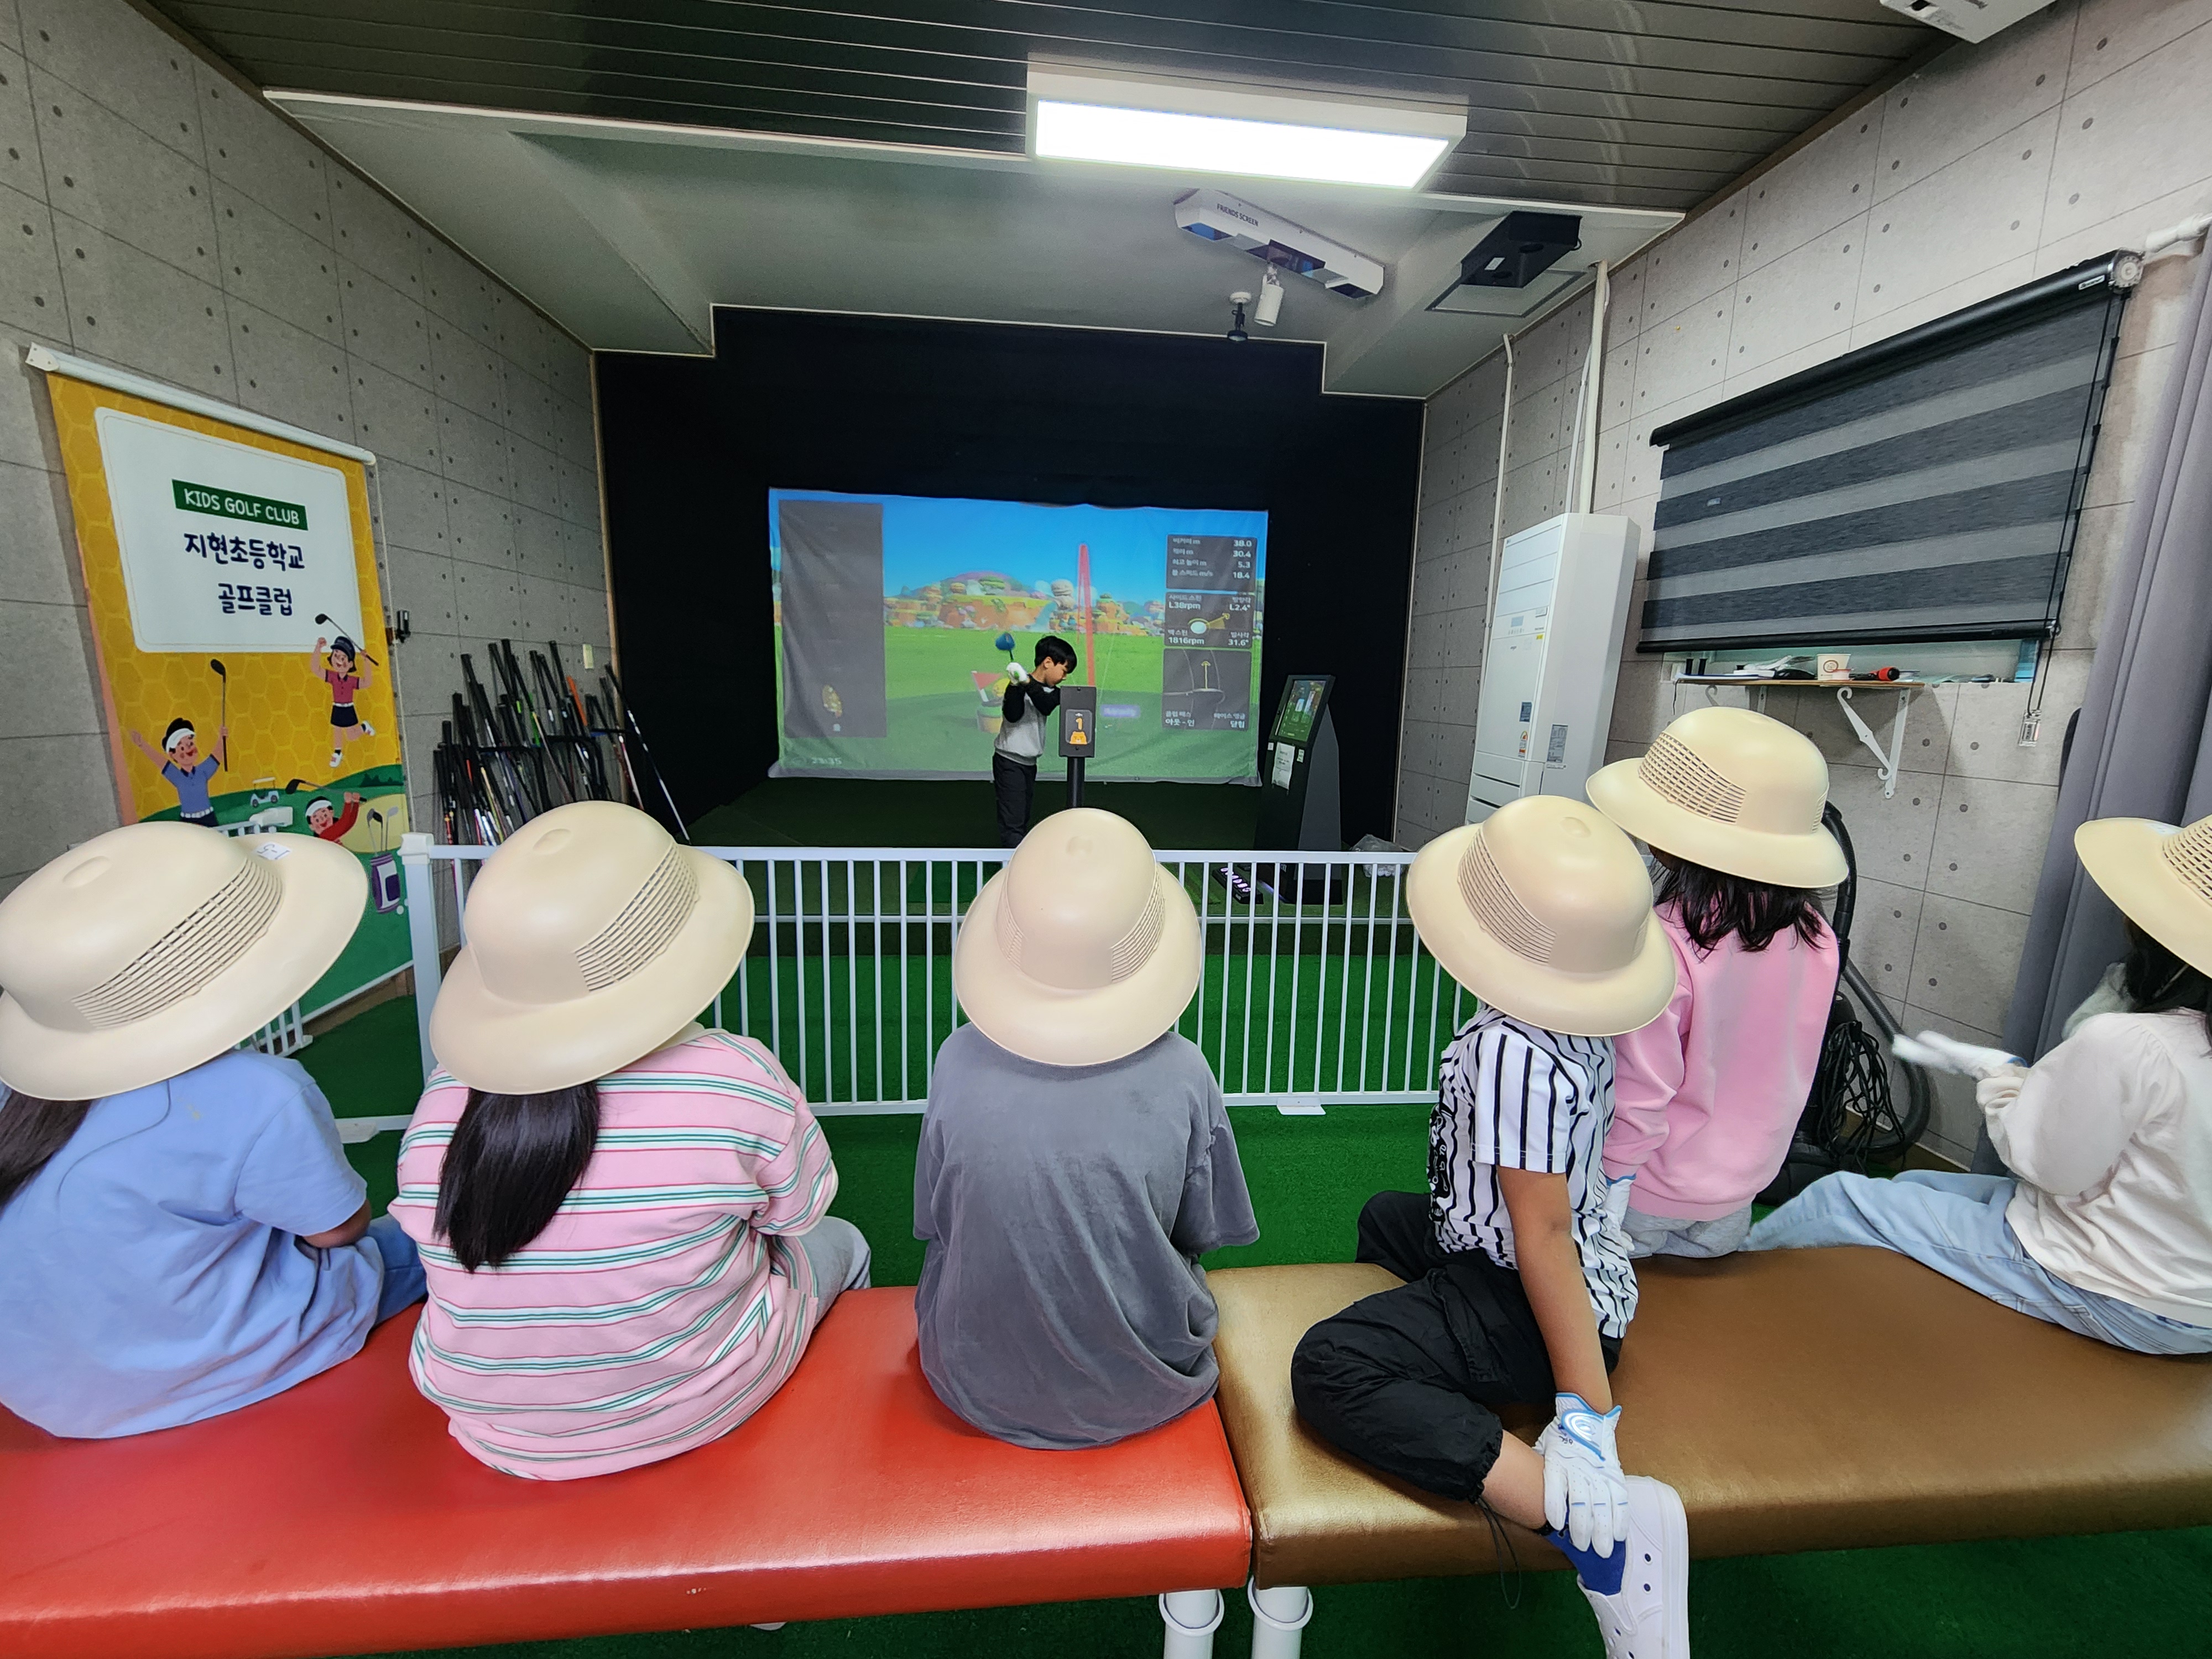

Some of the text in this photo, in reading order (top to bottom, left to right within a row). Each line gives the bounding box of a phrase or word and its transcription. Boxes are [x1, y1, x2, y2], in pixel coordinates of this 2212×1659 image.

[1217, 203, 1259, 227] FRIENDS SCREEN
[184, 488, 300, 524] KIDS GOLF CLUB
[184, 531, 305, 572] 지현초등학교
[218, 582, 293, 616] 골프클럽
[1168, 637, 1205, 645] 1816rpm
[1076, 717, 1083, 730] 1
